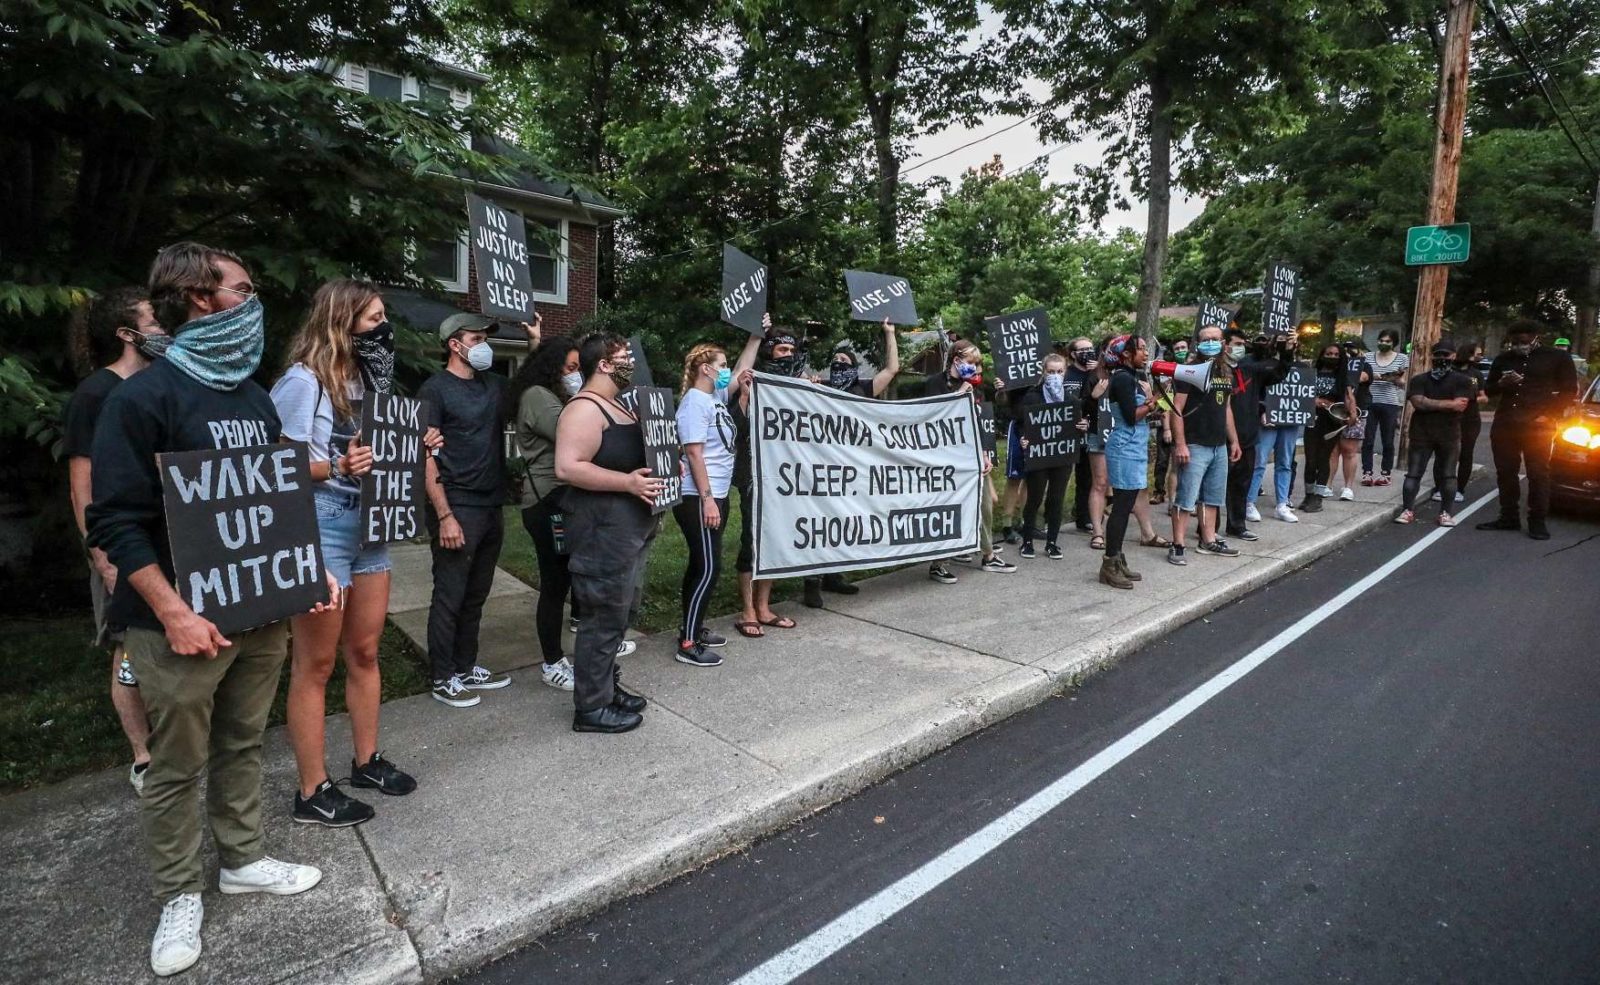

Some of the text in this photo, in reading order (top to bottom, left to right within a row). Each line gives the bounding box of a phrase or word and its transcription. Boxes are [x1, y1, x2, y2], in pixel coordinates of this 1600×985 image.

[485, 205, 508, 233] NO
[492, 258, 516, 286] NO
[1274, 264, 1296, 285] LOOK
[486, 281, 529, 312] SLEEP
[721, 267, 766, 320] RISE UP
[851, 280, 908, 314] RISE UP
[1272, 281, 1294, 300] US IN
[1203, 302, 1230, 323] LOOK
[1271, 297, 1290, 315] THE
[1000, 316, 1037, 335] LOOK
[1268, 312, 1290, 332] EYES
[1003, 331, 1040, 350] US IN
[1006, 347, 1038, 364] THE
[1008, 360, 1044, 380] EYES
[1268, 382, 1316, 398] JUSTICE
[373, 392, 421, 431] LOOK
[649, 391, 666, 418] NO
[1028, 405, 1074, 426] WAKE
[1270, 410, 1312, 424] SLEEP
[1279, 397, 1301, 411] NO
[645, 418, 678, 447] JUSTICE
[762, 406, 873, 446] BREONNA
[1040, 424, 1063, 440] UP
[371, 428, 419, 464] US IN
[1029, 438, 1076, 459] MITCH
[168, 449, 300, 505] WAKE
[656, 450, 672, 477] NO
[371, 469, 413, 502] THE
[776, 462, 957, 497] SLEEP. NEITHER
[215, 504, 274, 550] UP
[368, 505, 416, 542] EYES
[793, 509, 956, 550] SHOULD MITCH
[188, 543, 319, 615] MITCH
